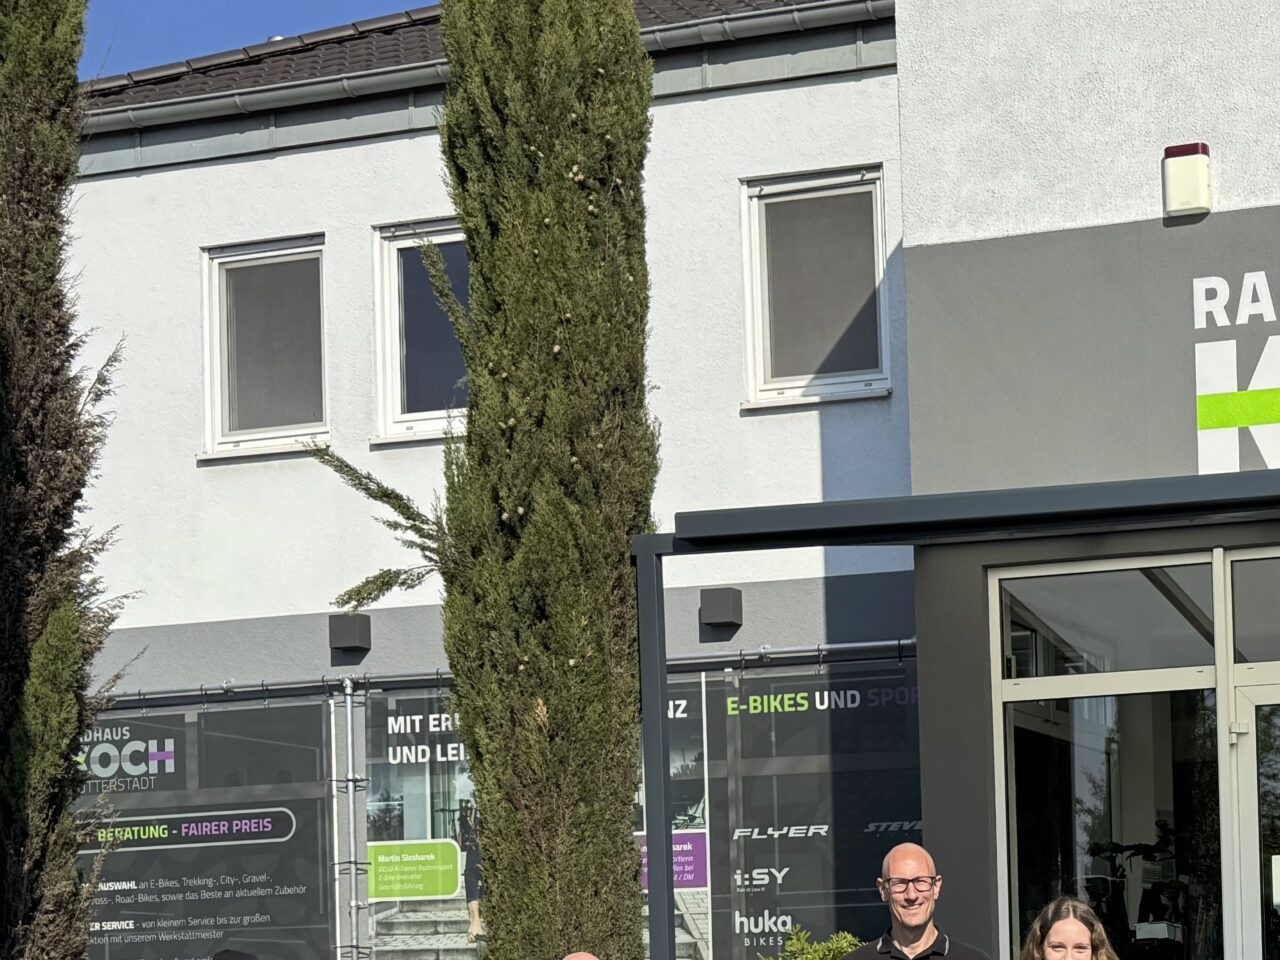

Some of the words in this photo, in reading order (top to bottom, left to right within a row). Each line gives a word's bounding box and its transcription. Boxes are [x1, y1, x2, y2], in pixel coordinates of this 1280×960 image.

[726, 692, 809, 716] E-BIKES
[814, 690, 860, 710] UND
[387, 715, 423, 735] MIT
[388, 744, 431, 765] UND
[436, 742, 470, 762] LEI
[97, 824, 169, 842] BERATUNG
[181, 820, 229, 837] FAIRER
[232, 818, 273, 834] PREIS
[732, 824, 829, 840] FLYER
[98, 880, 138, 891] AUSWAHL
[185, 891, 199, 900] das
[200, 889, 223, 899] Beste
[223, 890, 234, 898] an
[102, 920, 135, 930] SERVICE
[188, 916, 215, 926] Service
[735, 909, 792, 934] huka
[744, 936, 784, 946] BIKES
